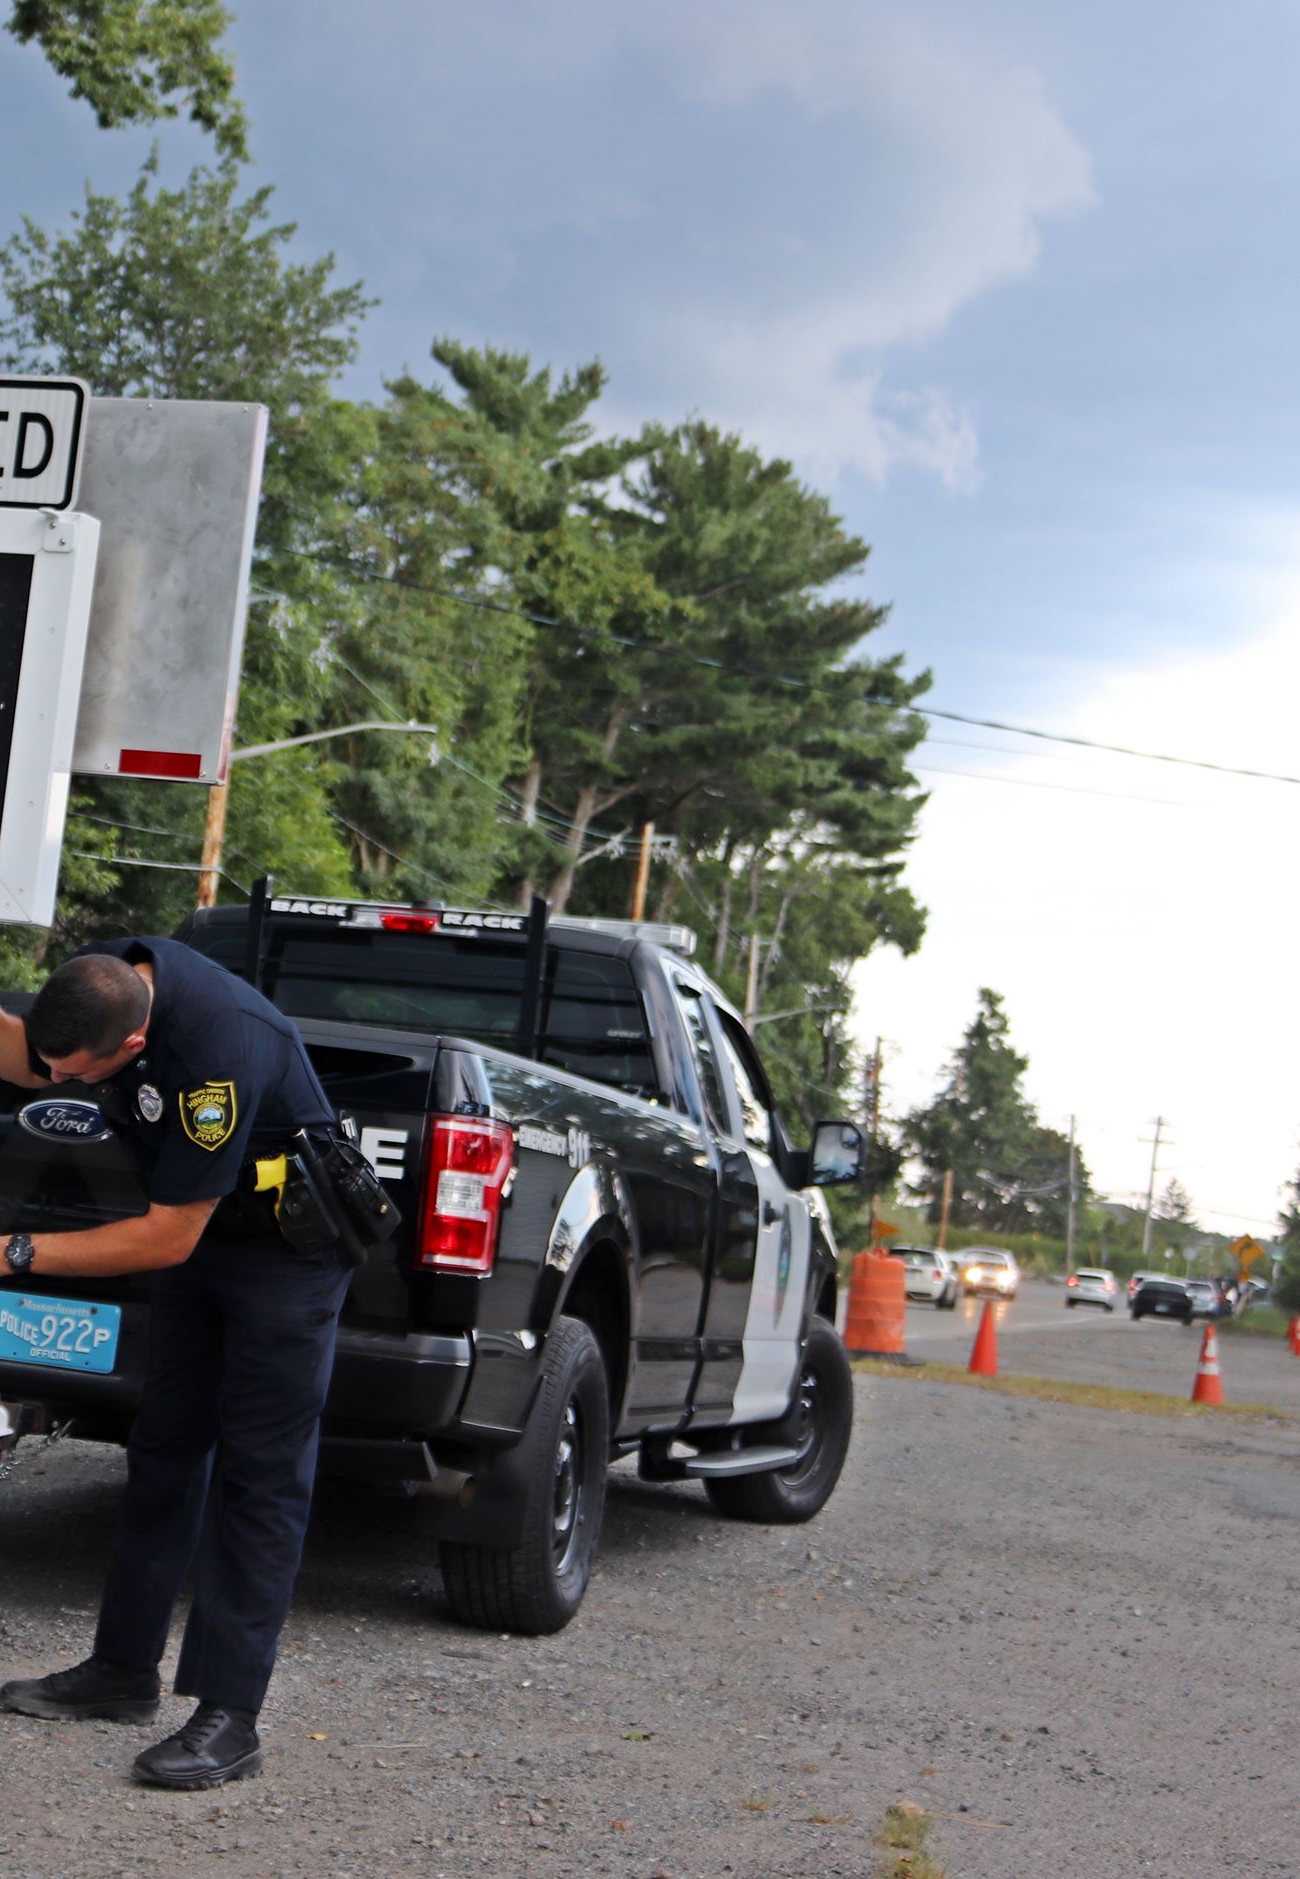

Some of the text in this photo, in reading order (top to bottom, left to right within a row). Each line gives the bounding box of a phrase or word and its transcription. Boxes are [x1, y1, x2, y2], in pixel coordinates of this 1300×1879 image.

[270, 899, 524, 930] BACK RACK
[186, 1094, 228, 1110] HINGHAM
[40, 1107, 95, 1134] Ford
[194, 1127, 226, 1143] POLICE
[0, 1310, 39, 1346] POLICE
[29, 1347, 72, 1362] OFFICIAL
